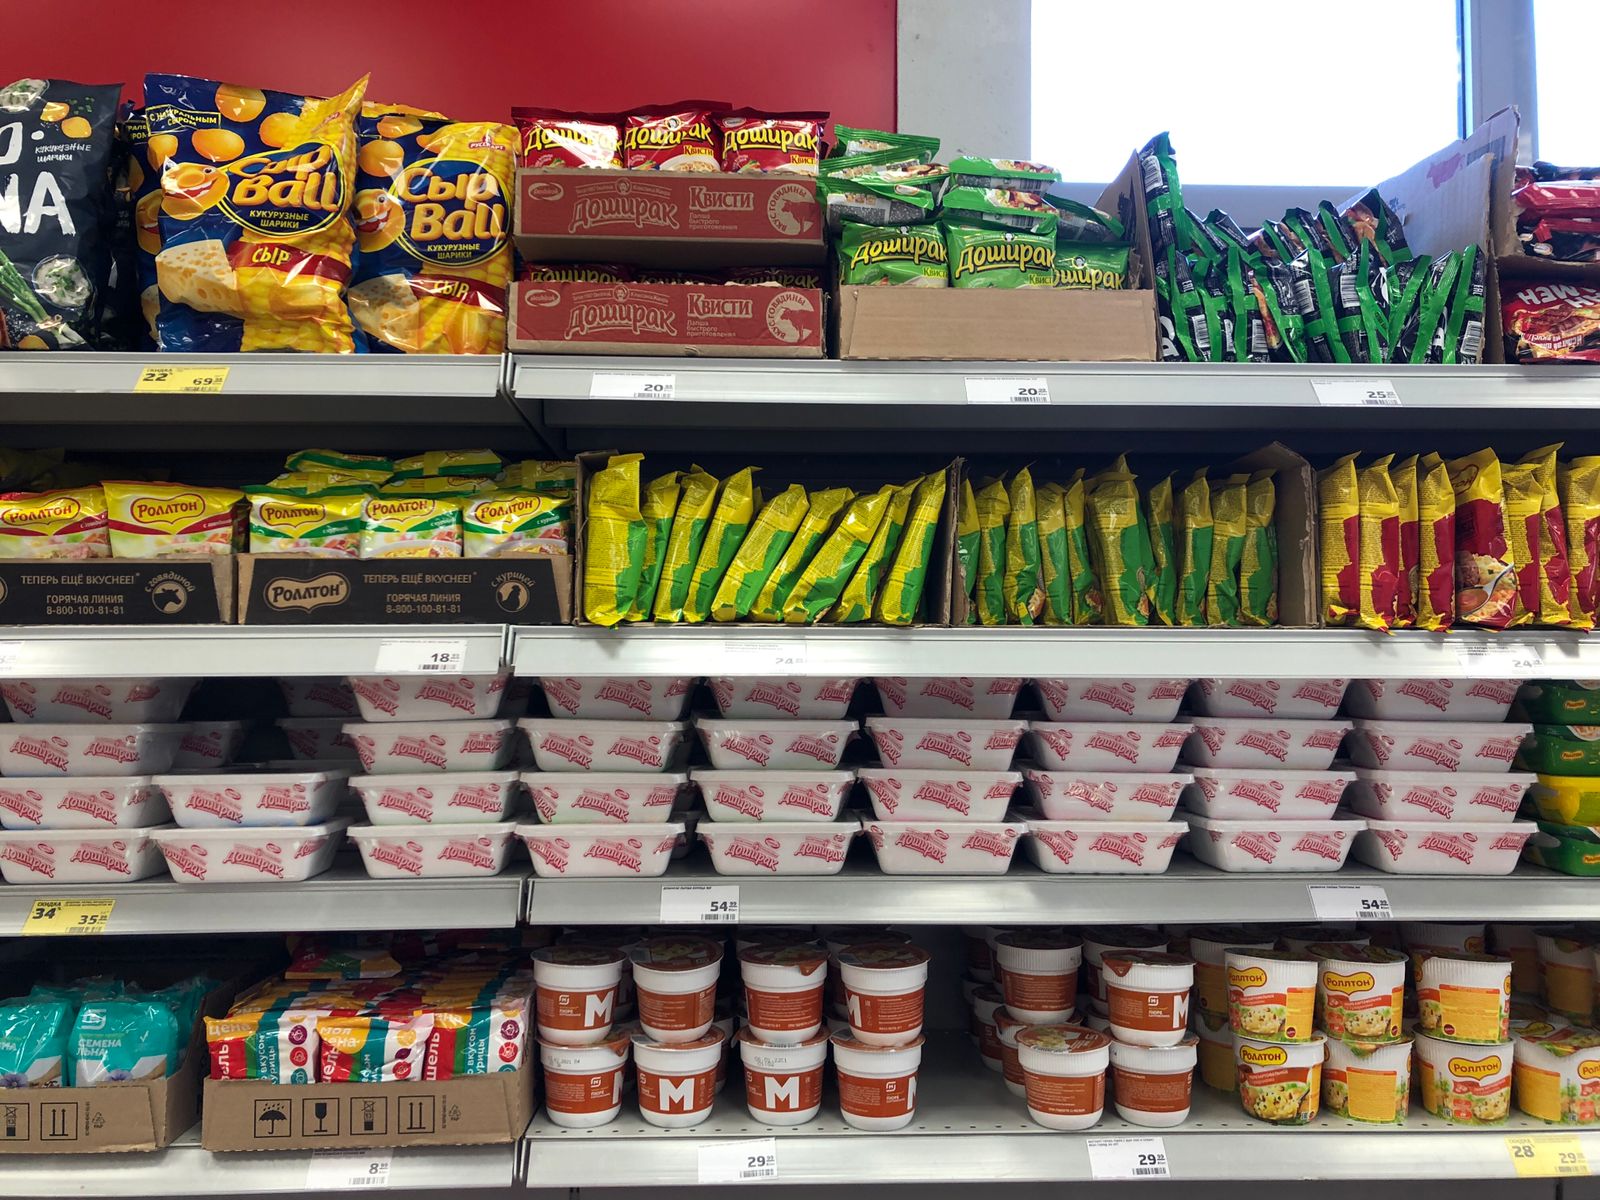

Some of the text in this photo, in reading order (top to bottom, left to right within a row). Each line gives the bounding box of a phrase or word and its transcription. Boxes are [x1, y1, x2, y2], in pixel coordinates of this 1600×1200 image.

[524, 126, 624, 159] Дошик
[722, 128, 820, 160] Доширак
[37, 153, 73, 163] ШАРИКИ
[790, 154, 816, 165] Квист
[233, 171, 339, 212] Ball
[398, 167, 500, 210] Сыр
[688, 185, 754, 212] Квисти
[769, 183, 808, 212] ГОВЯДИНЫ
[249, 209, 309, 222] КУКУРУЗНЫЕ
[260, 219, 300, 229] ШАРИКИ
[410, 202, 506, 242] Ball
[568, 196, 680, 234] Доширак
[252, 247, 290, 264] СЫР
[427, 243, 480, 252] КУКУРУЗНЫЕ
[437, 251, 472, 260] ШАРИКИ
[850, 236, 949, 271] Доширак
[955, 243, 1057, 280] Доширак
[433, 278, 470, 298] СЫР
[1054, 268, 1125, 291] оширак
[686, 292, 753, 319] Квисти
[768, 293, 807, 319] ГОВЯДИНЫ
[564, 304, 678, 340] Доширак
[142, 372, 169, 382] 22
[193, 377, 213, 386] 69
[643, 384, 664, 392] 20
[1018, 387, 1038, 396] 20
[1366, 390, 1387, 399] 25
[20, 574, 59, 586] ТЕПЕРЬ
[61, 573, 85, 586] ЕЩЁ
[148, 570, 197, 593] говядиной
[363, 574, 400, 585] ТЕПЕРЬ
[401, 572, 424, 585] ЕЩЁ
[496, 571, 536, 589] курицей
[46, 594, 124, 605] ГОРЯЧАЯ ЛИНИЯ
[46, 605, 124, 616] 8-800-100-81-81
[385, 604, 462, 614] 8-800-100-81-81
[386, 593, 462, 603] ГОРЯЧАЯ ЛИНИЯ
[431, 653, 450, 663] 18
[10, 741, 70, 772] Доширак
[83, 743, 140, 763] Доширак
[389, 742, 448, 770] Доширак
[539, 736, 593, 770] Доширак
[607, 742, 663, 768] Доширак
[720, 736, 770, 767] Доширак
[785, 738, 839, 766] Доширак
[916, 736, 972, 767] Доширак
[1084, 735, 1140, 764] Доширак
[1236, 731, 1288, 762] Доширак
[1404, 743, 1461, 772] Доширак
[185, 794, 244, 824] Доширак
[256, 792, 311, 813] Доширак
[377, 793, 434, 823] Доширак
[447, 791, 504, 813] Доширак
[571, 794, 630, 823] Доширак
[712, 789, 764, 821] Доширак
[777, 788, 834, 817] Доширак
[913, 783, 970, 816] Доширак
[1063, 782, 1114, 813] Доширак
[1128, 786, 1177, 808] Доширак
[1228, 782, 1280, 813] Доширак
[1401, 789, 1455, 820] Доширак
[1469, 788, 1520, 813] Доширак
[57, 796, 118, 826] Доширак
[437, 845, 497, 870] Доширак
[583, 843, 642, 873] Доширак
[724, 842, 780, 872] Доширак
[793, 842, 846, 864] Доширак
[895, 831, 947, 864] Доширак
[961, 832, 1012, 858] Доширак
[1089, 835, 1146, 867] Доширак
[1231, 833, 1277, 865] Доширак
[1291, 835, 1341, 863] Доширак
[1418, 835, 1474, 865] Доширак
[1, 847, 56, 878] Доширак
[70, 848, 131, 875] Доширак
[223, 849, 285, 879] Доширак
[369, 846, 423, 876] Доширак
[31, 907, 56, 920] 34
[710, 901, 728, 912] 54
[1361, 899, 1380, 910] 54
[78, 915, 99, 925] 35
[584, 990, 615, 1028] М
[208, 1022, 251, 1036] цена
[76, 1047, 109, 1057] ЛЬНА
[77, 1038, 122, 1048] СЕМЕНА
[467, 1027, 477, 1066] вкусом
[658, 1077, 695, 1112] М
[764, 1076, 800, 1109] М
[747, 1155, 766, 1168] 29
[1138, 1153, 1157, 1166] 29
[1511, 1145, 1535, 1158] 28
[1558, 1152, 1577, 1164] 29
[368, 1163, 379, 1175] 8
